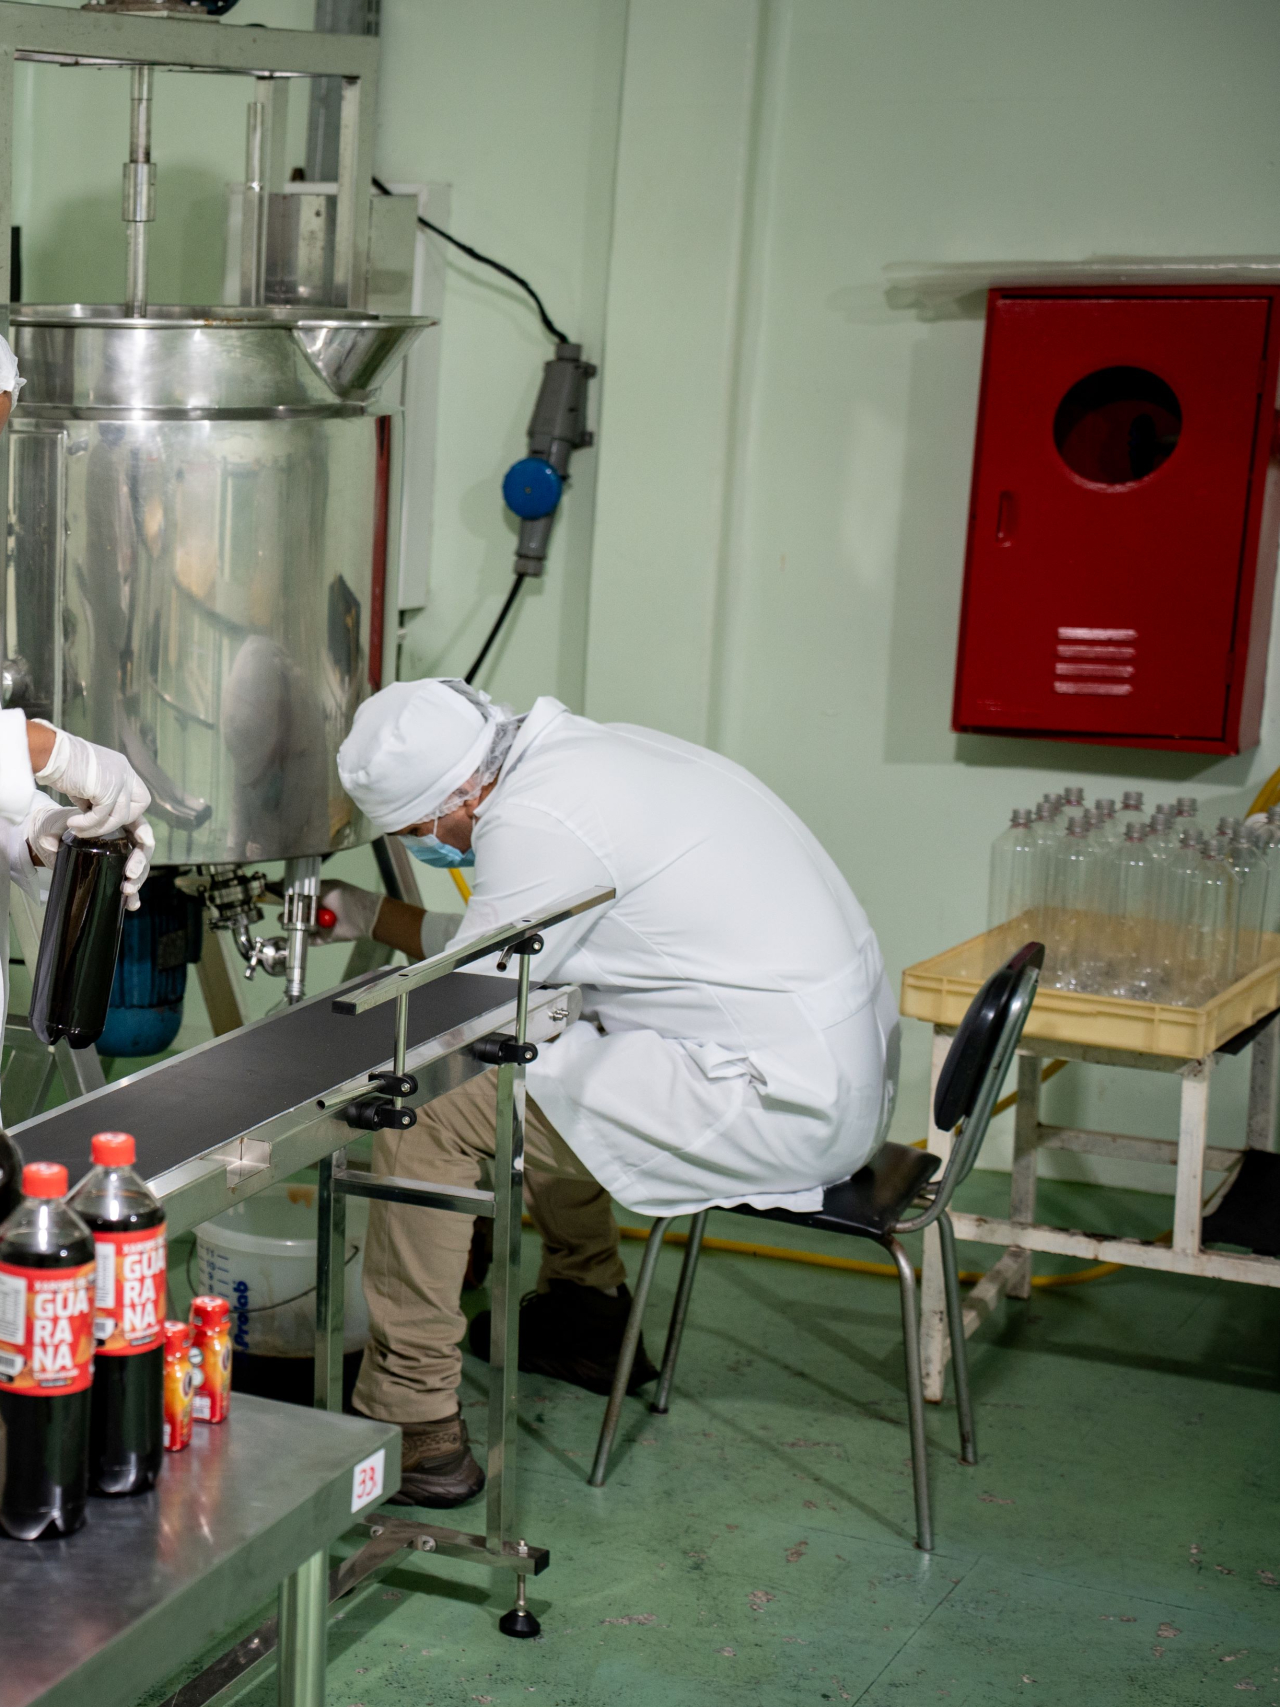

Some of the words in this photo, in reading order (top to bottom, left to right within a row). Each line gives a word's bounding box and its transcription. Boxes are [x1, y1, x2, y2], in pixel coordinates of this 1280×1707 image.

[123, 1247, 166, 1280] GUA
[34, 1289, 89, 1318] GUA
[123, 1277, 156, 1305] RA
[233, 1281, 249, 1350] Prolab
[33, 1318, 73, 1345] RA
[357, 1466, 377, 1499] 33
